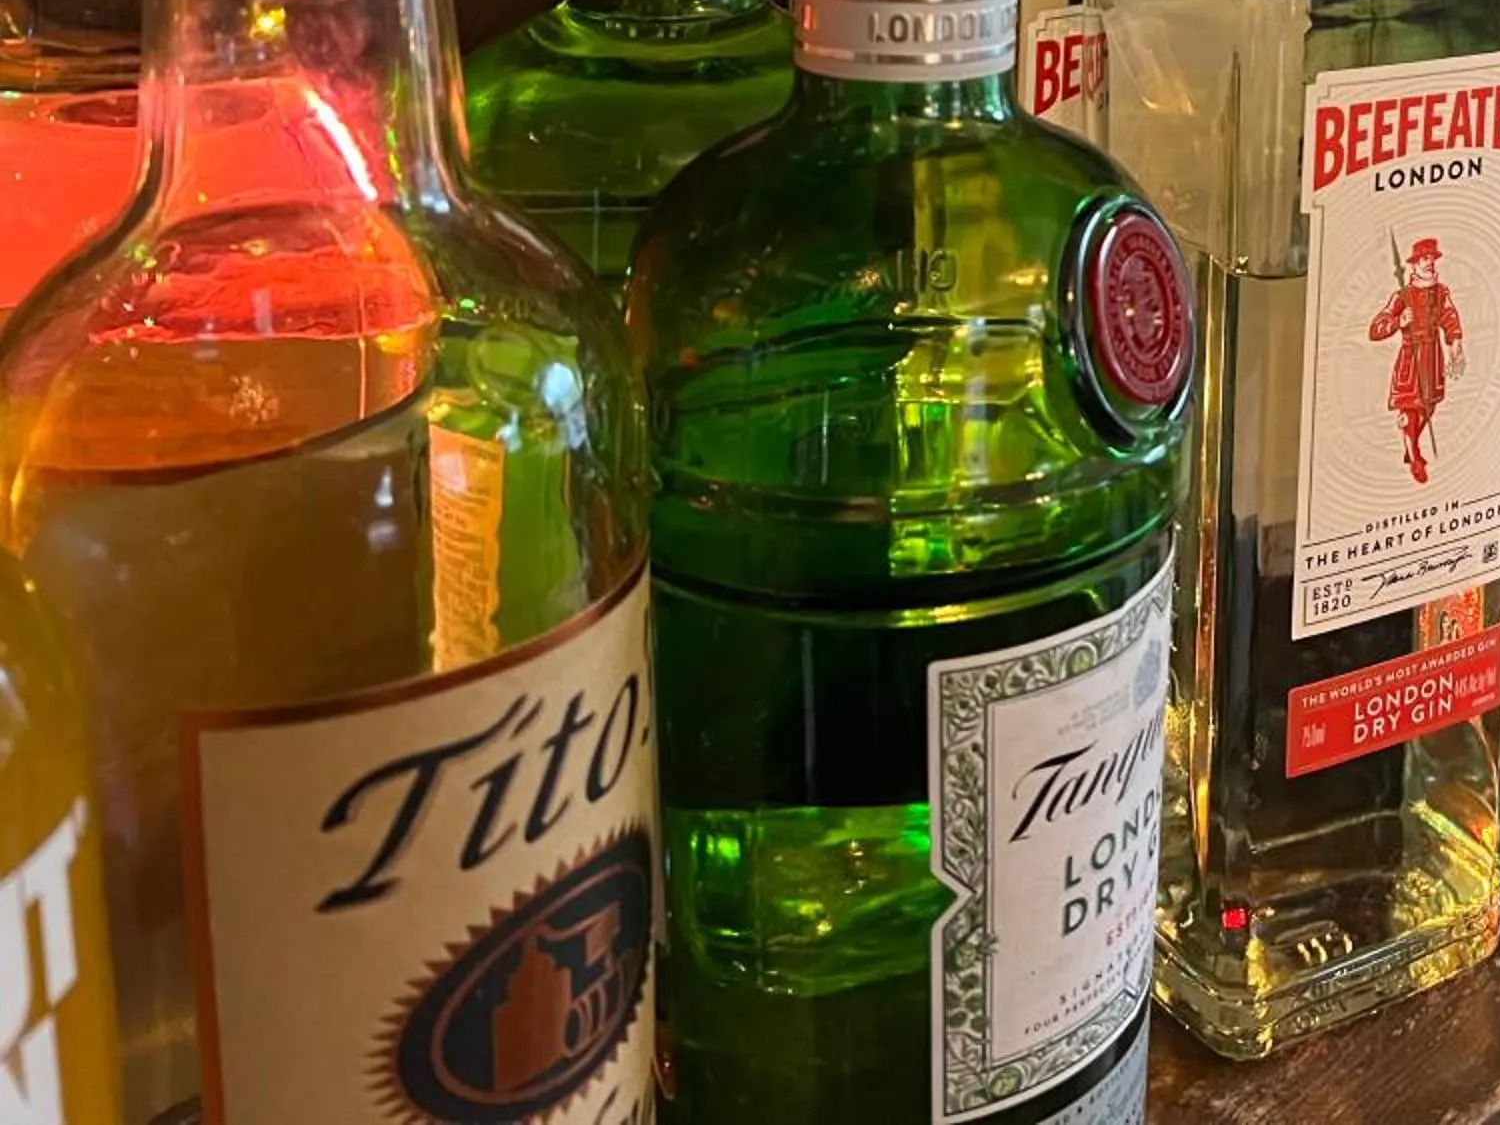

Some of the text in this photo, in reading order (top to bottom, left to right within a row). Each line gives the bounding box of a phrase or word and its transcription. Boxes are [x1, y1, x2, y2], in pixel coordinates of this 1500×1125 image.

[1375, 157, 1483, 192] LONDON
[1365, 507, 1438, 534] DISTILLED
[1305, 551, 1339, 570] THE
[1347, 533, 1405, 560] HEART
[1411, 525, 1432, 542] OF
[1314, 595, 1352, 616] 1820
[1302, 693, 1326, 708] THE
[1386, 664, 1418, 683] MOST
[1355, 673, 1453, 721] LONDON
[1354, 709, 1401, 744] DRY
[1412, 696, 1453, 724] GIN
[1061, 851, 1138, 939] DRY
